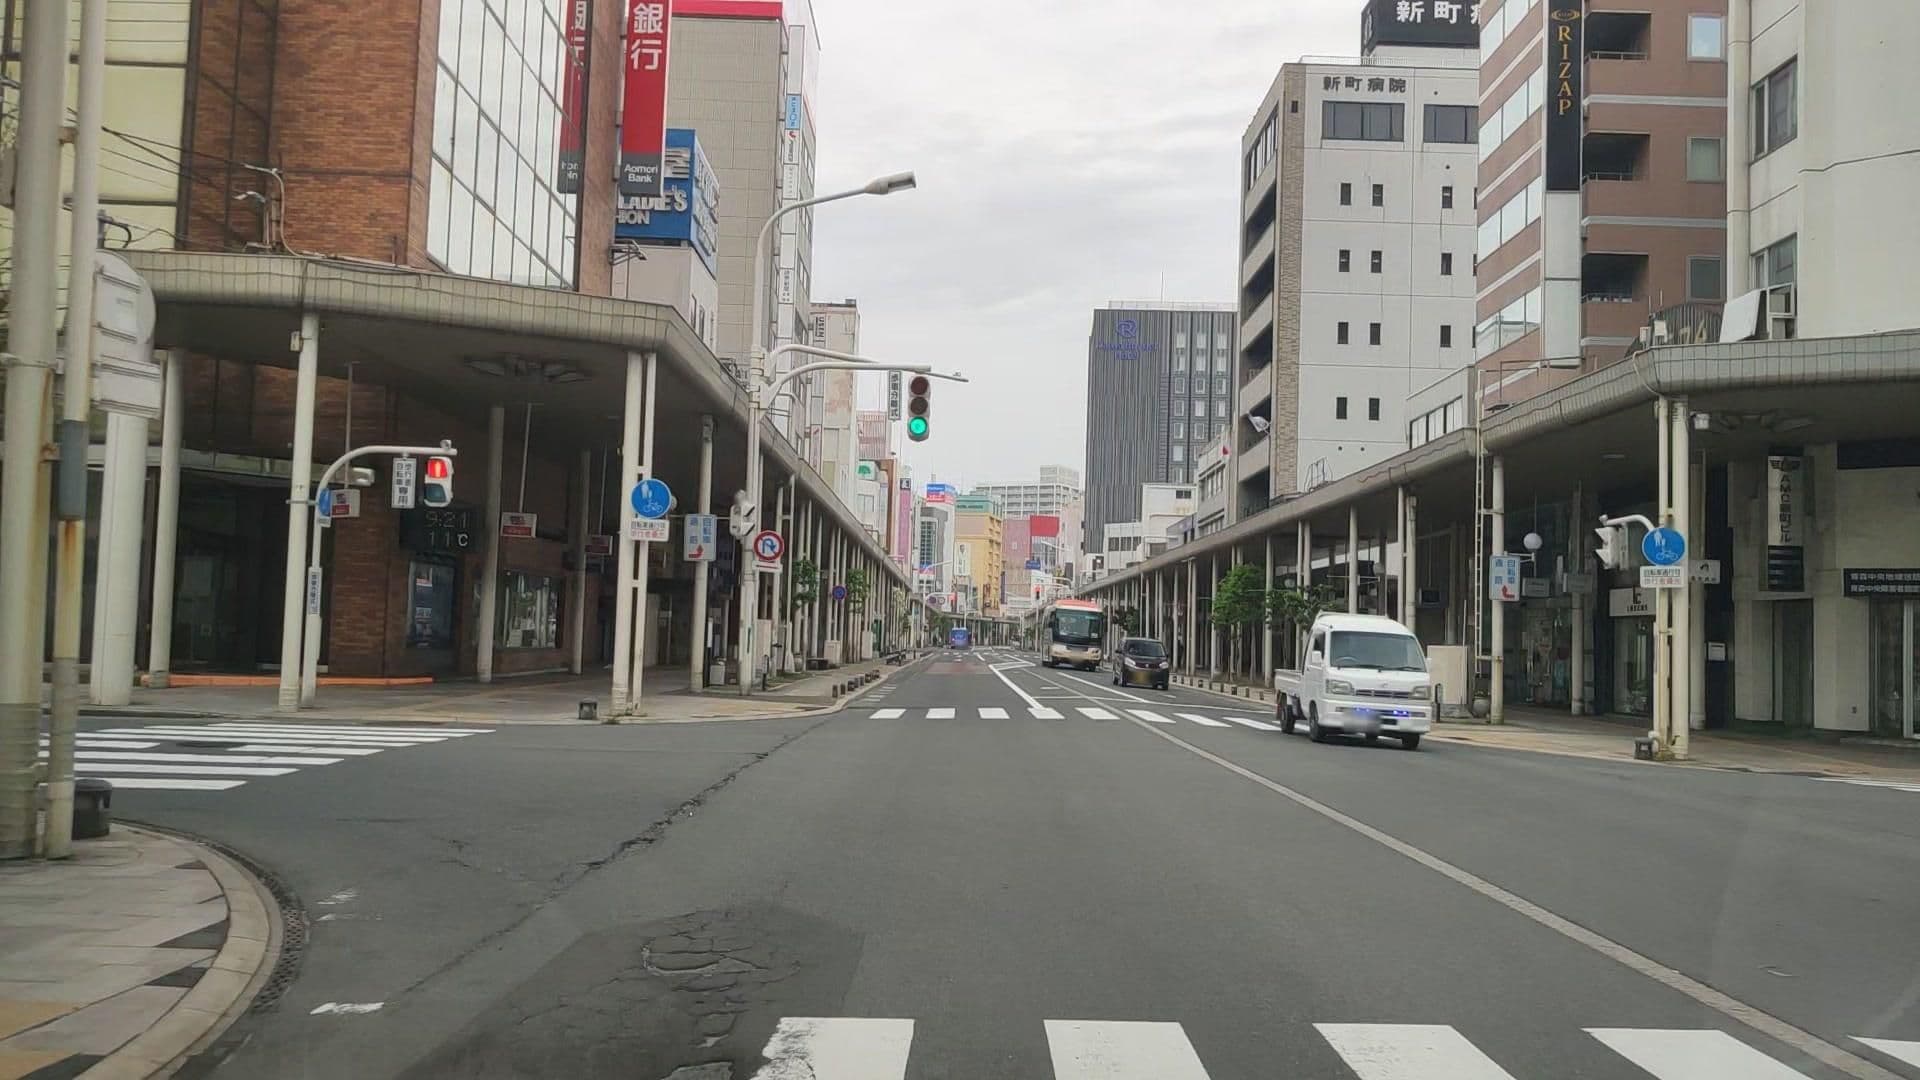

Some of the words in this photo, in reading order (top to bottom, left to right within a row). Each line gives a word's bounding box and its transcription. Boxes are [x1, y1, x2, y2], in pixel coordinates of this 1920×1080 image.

[630, 2, 664, 71] 銀行
[1557, 25, 1574, 116] RIZAP
[1323, 76, 1407, 94] 新町病院
[624, 163, 658, 174] Aomori
[628, 174, 653, 183] Bank
